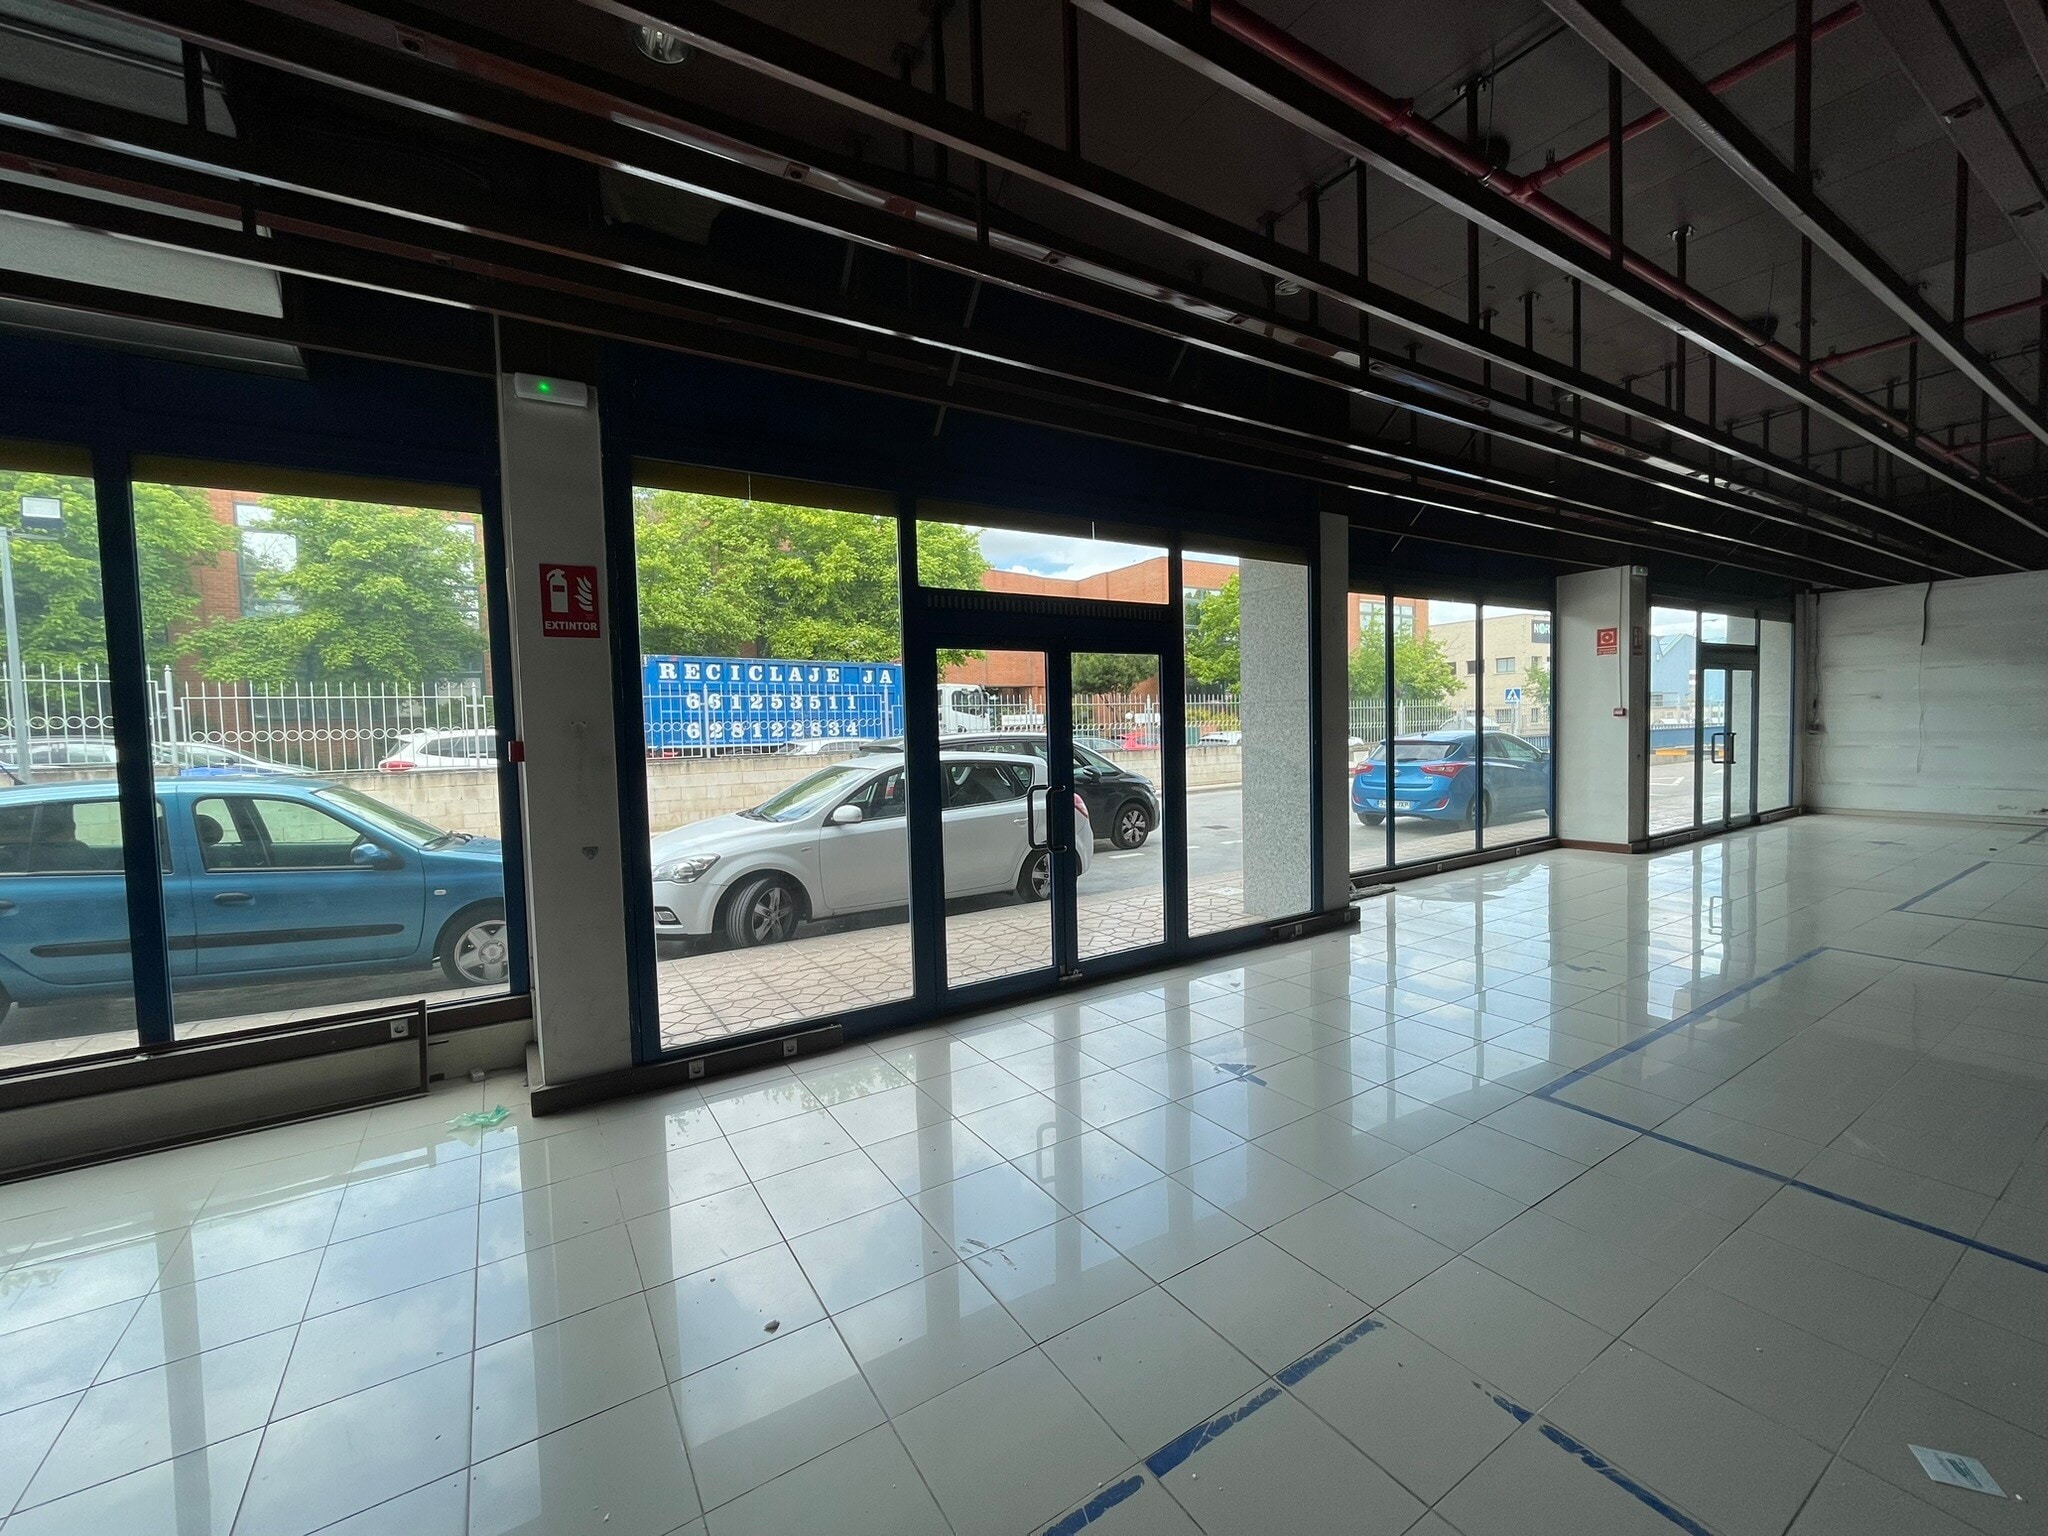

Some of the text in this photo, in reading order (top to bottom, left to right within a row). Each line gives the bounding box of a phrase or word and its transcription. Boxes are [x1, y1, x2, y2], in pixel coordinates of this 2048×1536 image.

[545, 620, 598, 631] EXTINTOR
[658, 663, 893, 684] RECICLAJE JA
[686, 692, 857, 710] 661253511
